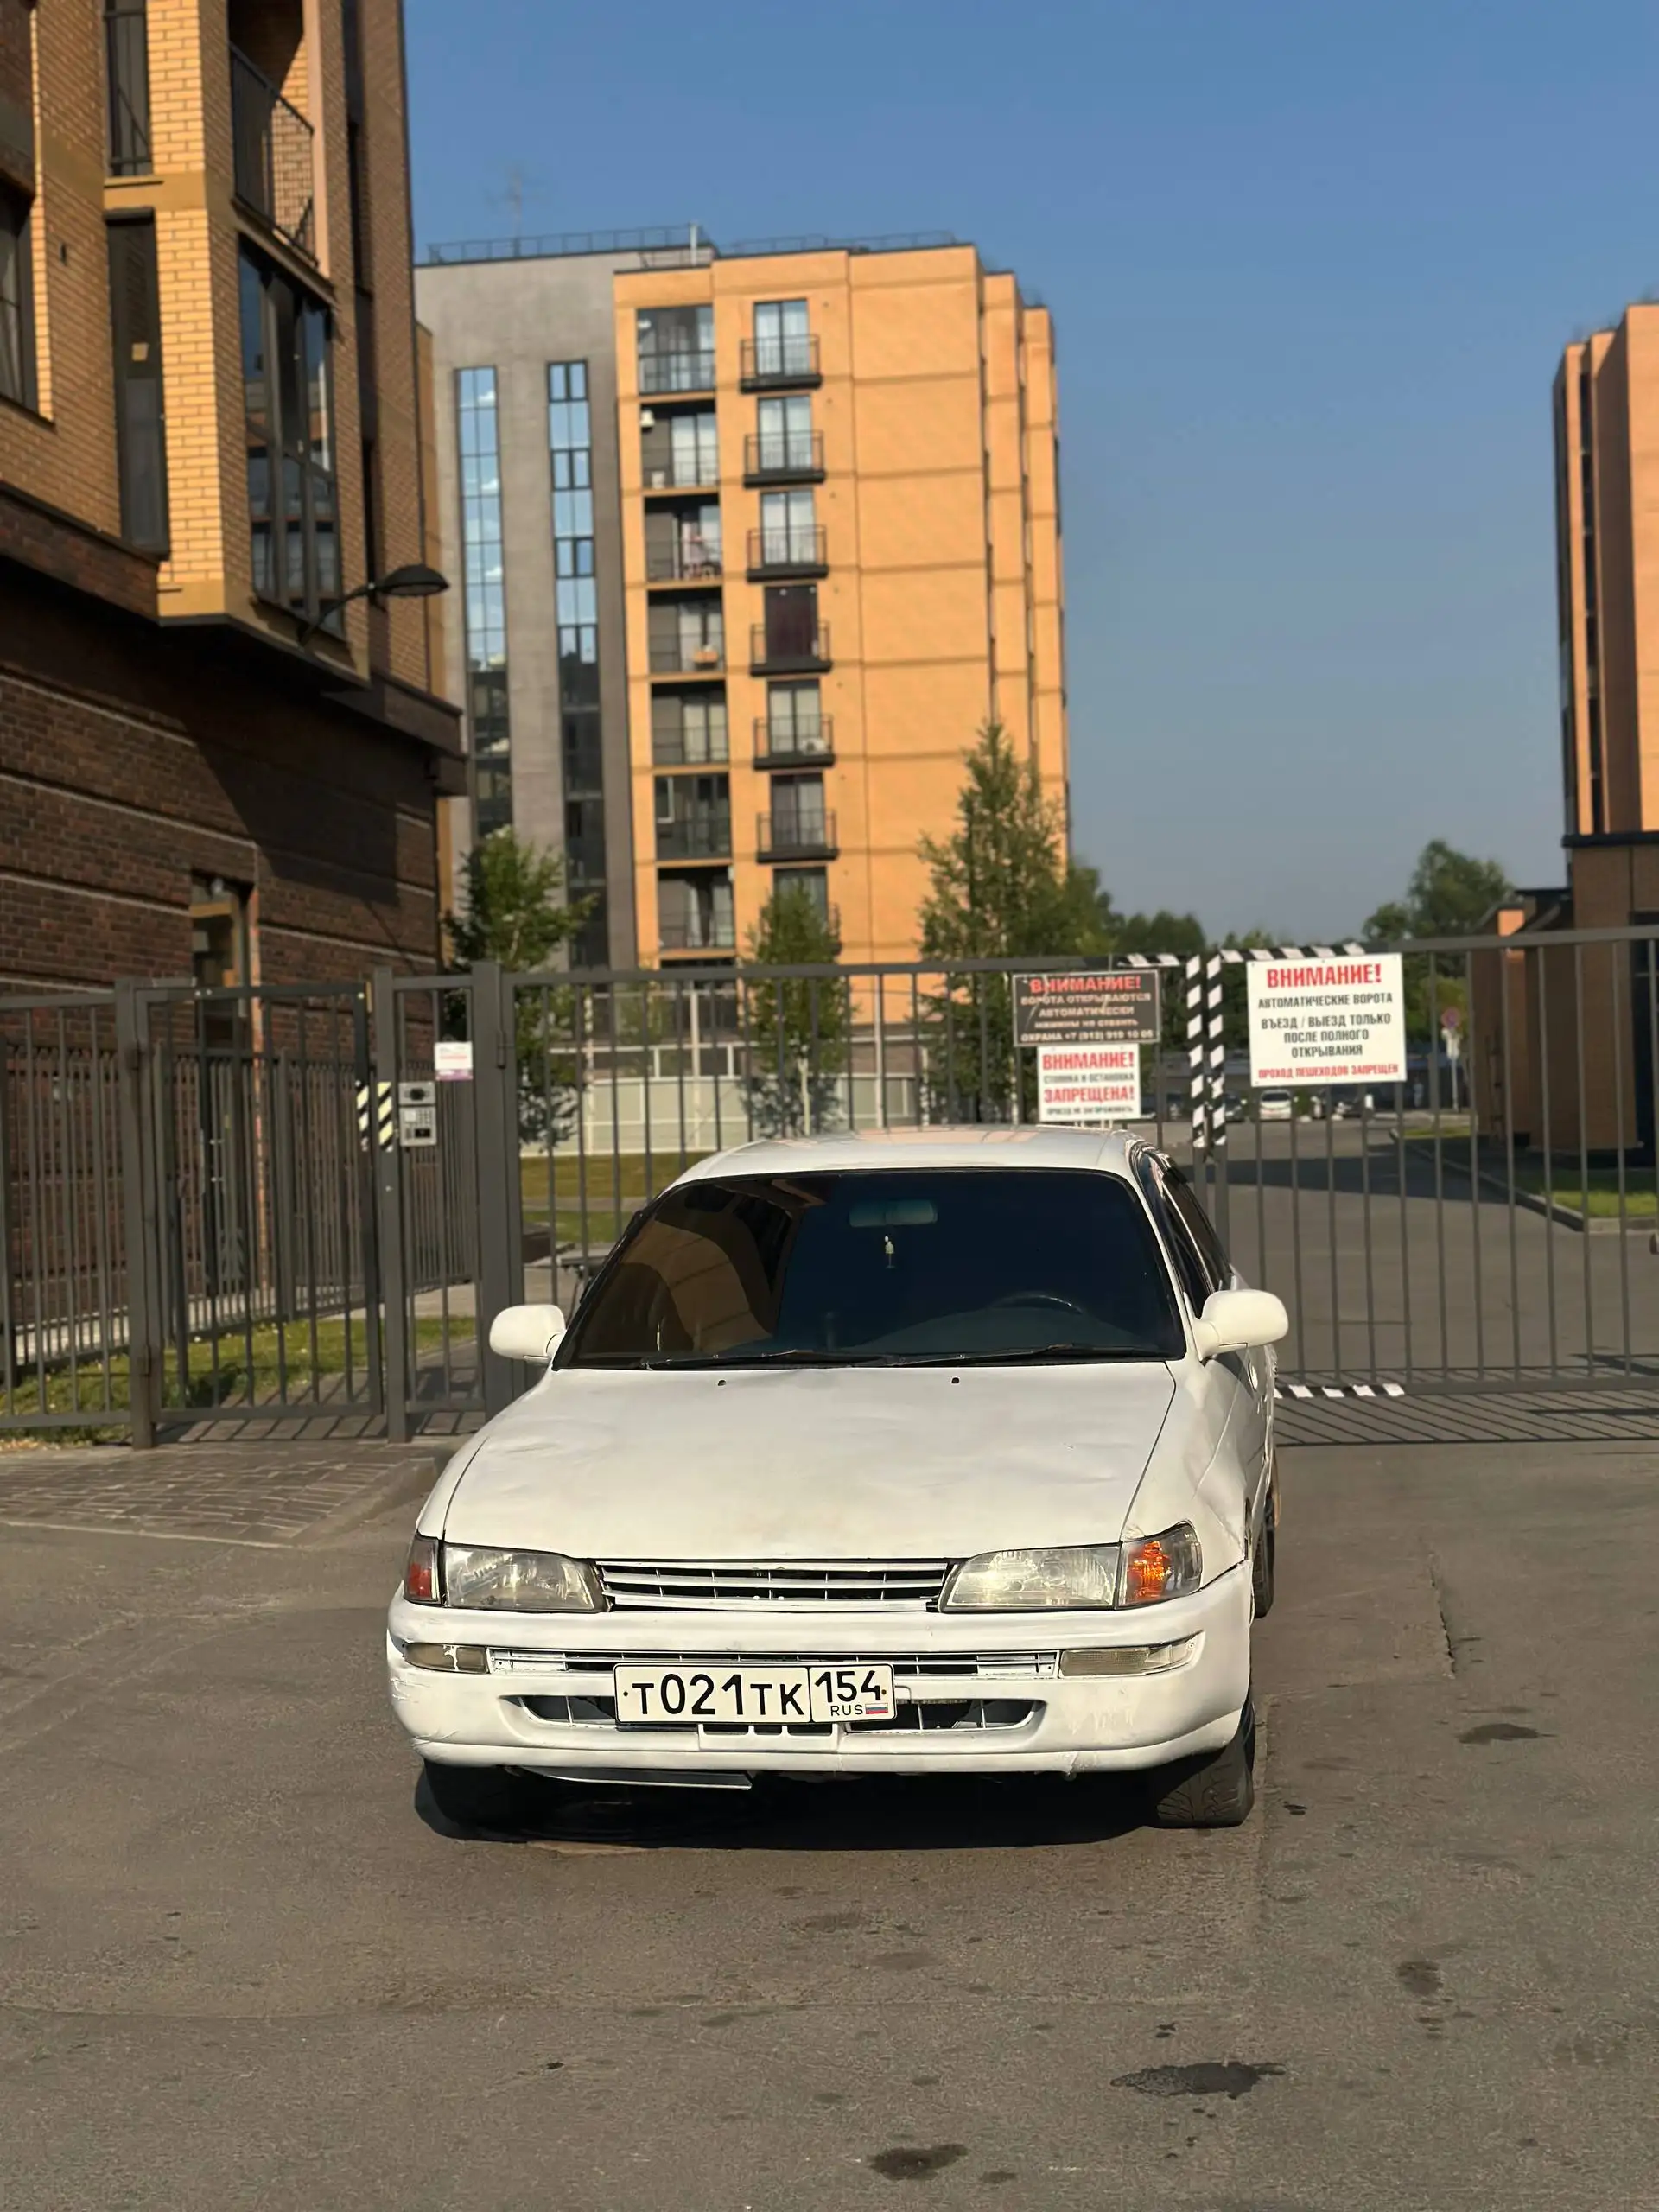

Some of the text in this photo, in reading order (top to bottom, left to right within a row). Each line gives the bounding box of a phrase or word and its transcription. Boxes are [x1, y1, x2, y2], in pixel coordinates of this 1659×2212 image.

[1267, 963, 1382, 988] ВНИМАНИЕ!
[1029, 976, 1141, 993] ВНИМАНИЕ!
[1020, 993, 1151, 1005] ВОРОТА ОТКРЫВАЮТСЯ
[1258, 993, 1393, 1009] АВТОМАТИЧЕСКИЕ ВОРОТА
[1039, 1007, 1134, 1017] АВТОМАТИЧЕСКИ
[1262, 1018, 1298, 1030] ВЪЕЗД
[1308, 1015, 1347, 1028] ВЫЕЗД
[1350, 1013, 1390, 1026] ТОЛЬКО
[1020, 1033, 1063, 1042] ОХРАНА
[1284, 1029, 1369, 1043] ПОСЛЕ ПОЛНОГО
[1291, 1045, 1363, 1058] ОТКРЫВАНИЯ
[1043, 1051, 1134, 1070] ВНИМАНИЕ!
[1258, 1064, 1398, 1078] ПРОХОД ПЕШЕХОДОВ ЗАПРЕЩЕН
[1044, 1085, 1134, 1103] ЗАПРЕЩЕНА!
[815, 1670, 883, 1703] 154
[830, 1704, 863, 1717] RUS
